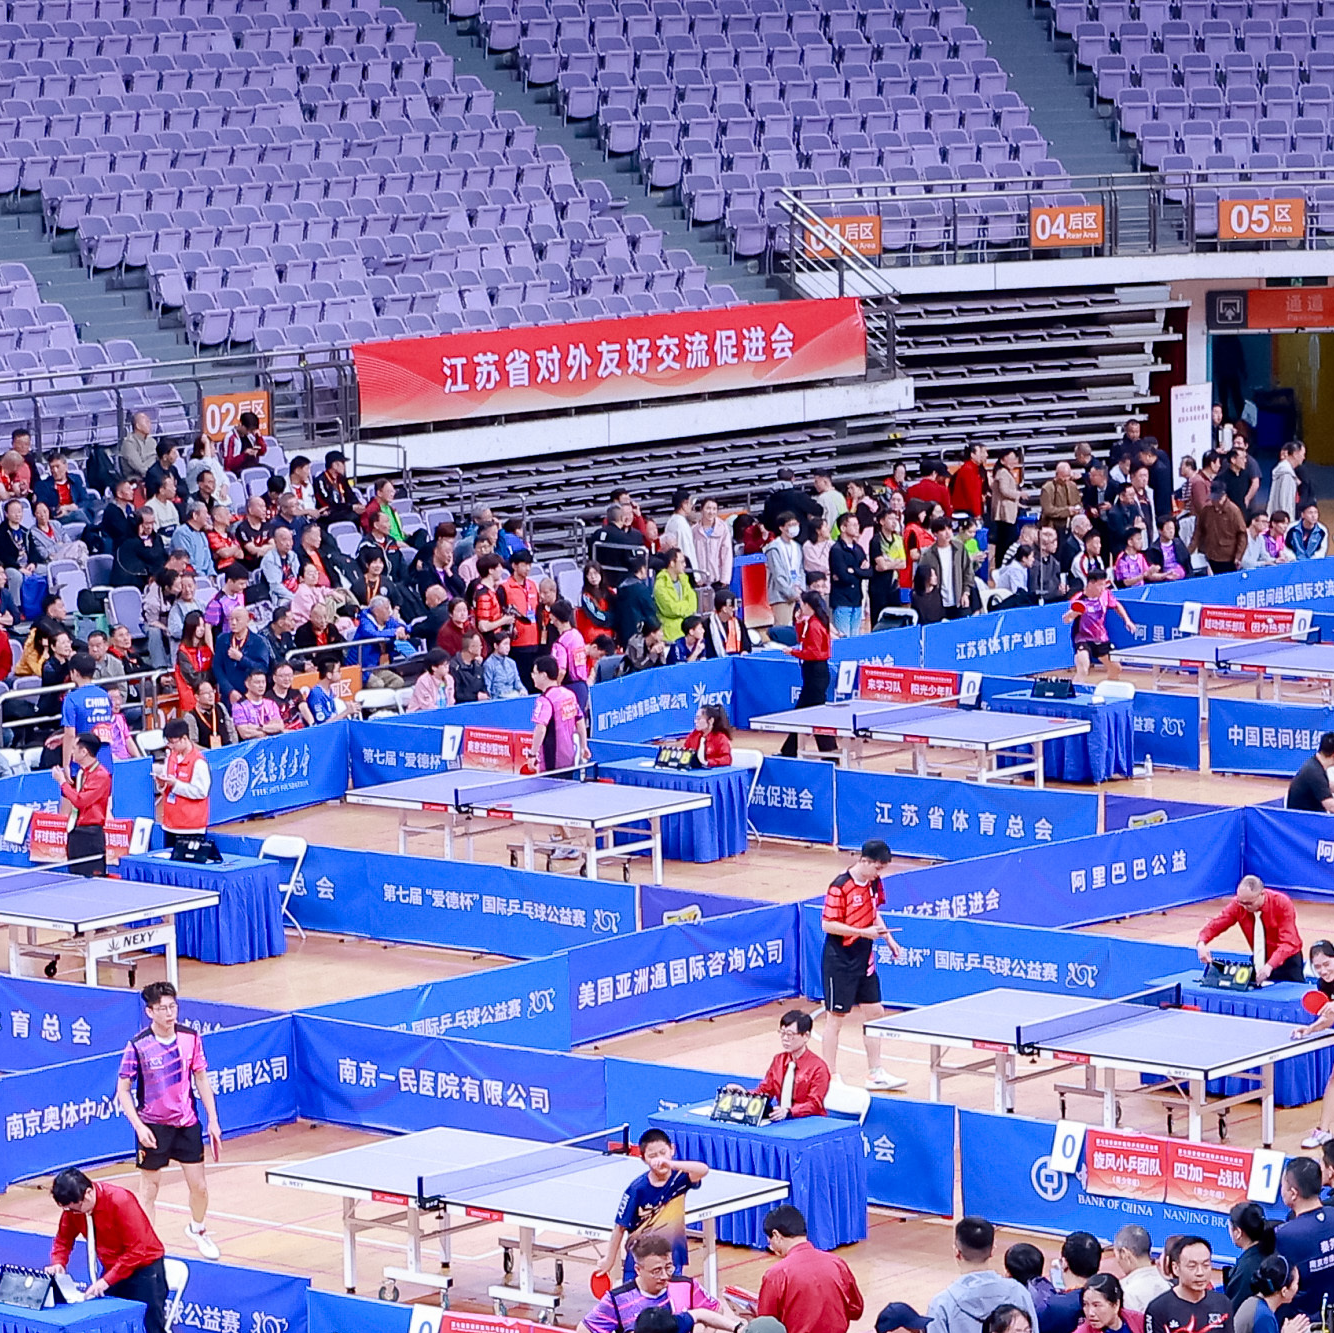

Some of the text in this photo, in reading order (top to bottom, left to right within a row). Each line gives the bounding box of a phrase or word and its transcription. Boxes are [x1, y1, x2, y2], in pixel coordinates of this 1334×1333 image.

[1036, 211, 1065, 240] 04
[1230, 205, 1269, 233] 05
[442, 322, 794, 395] 江苏省对外友好交流促进会
[206, 403, 235, 435] 02
[876, 802, 1053, 841] 江苏省体育总会
[1071, 850, 1187, 894] 阿里巴巴公益
[124, 931, 154, 947] NEXY
[577, 938, 784, 1010] 美国亚洲通国际咨询公司
[339, 1057, 550, 1114] 南京一民医院有限公司
[1062, 1135, 1076, 1158] 0
[1262, 1164, 1273, 1188] 1
[1078, 1194, 1208, 1226] BANK OF CHINA NANJING
